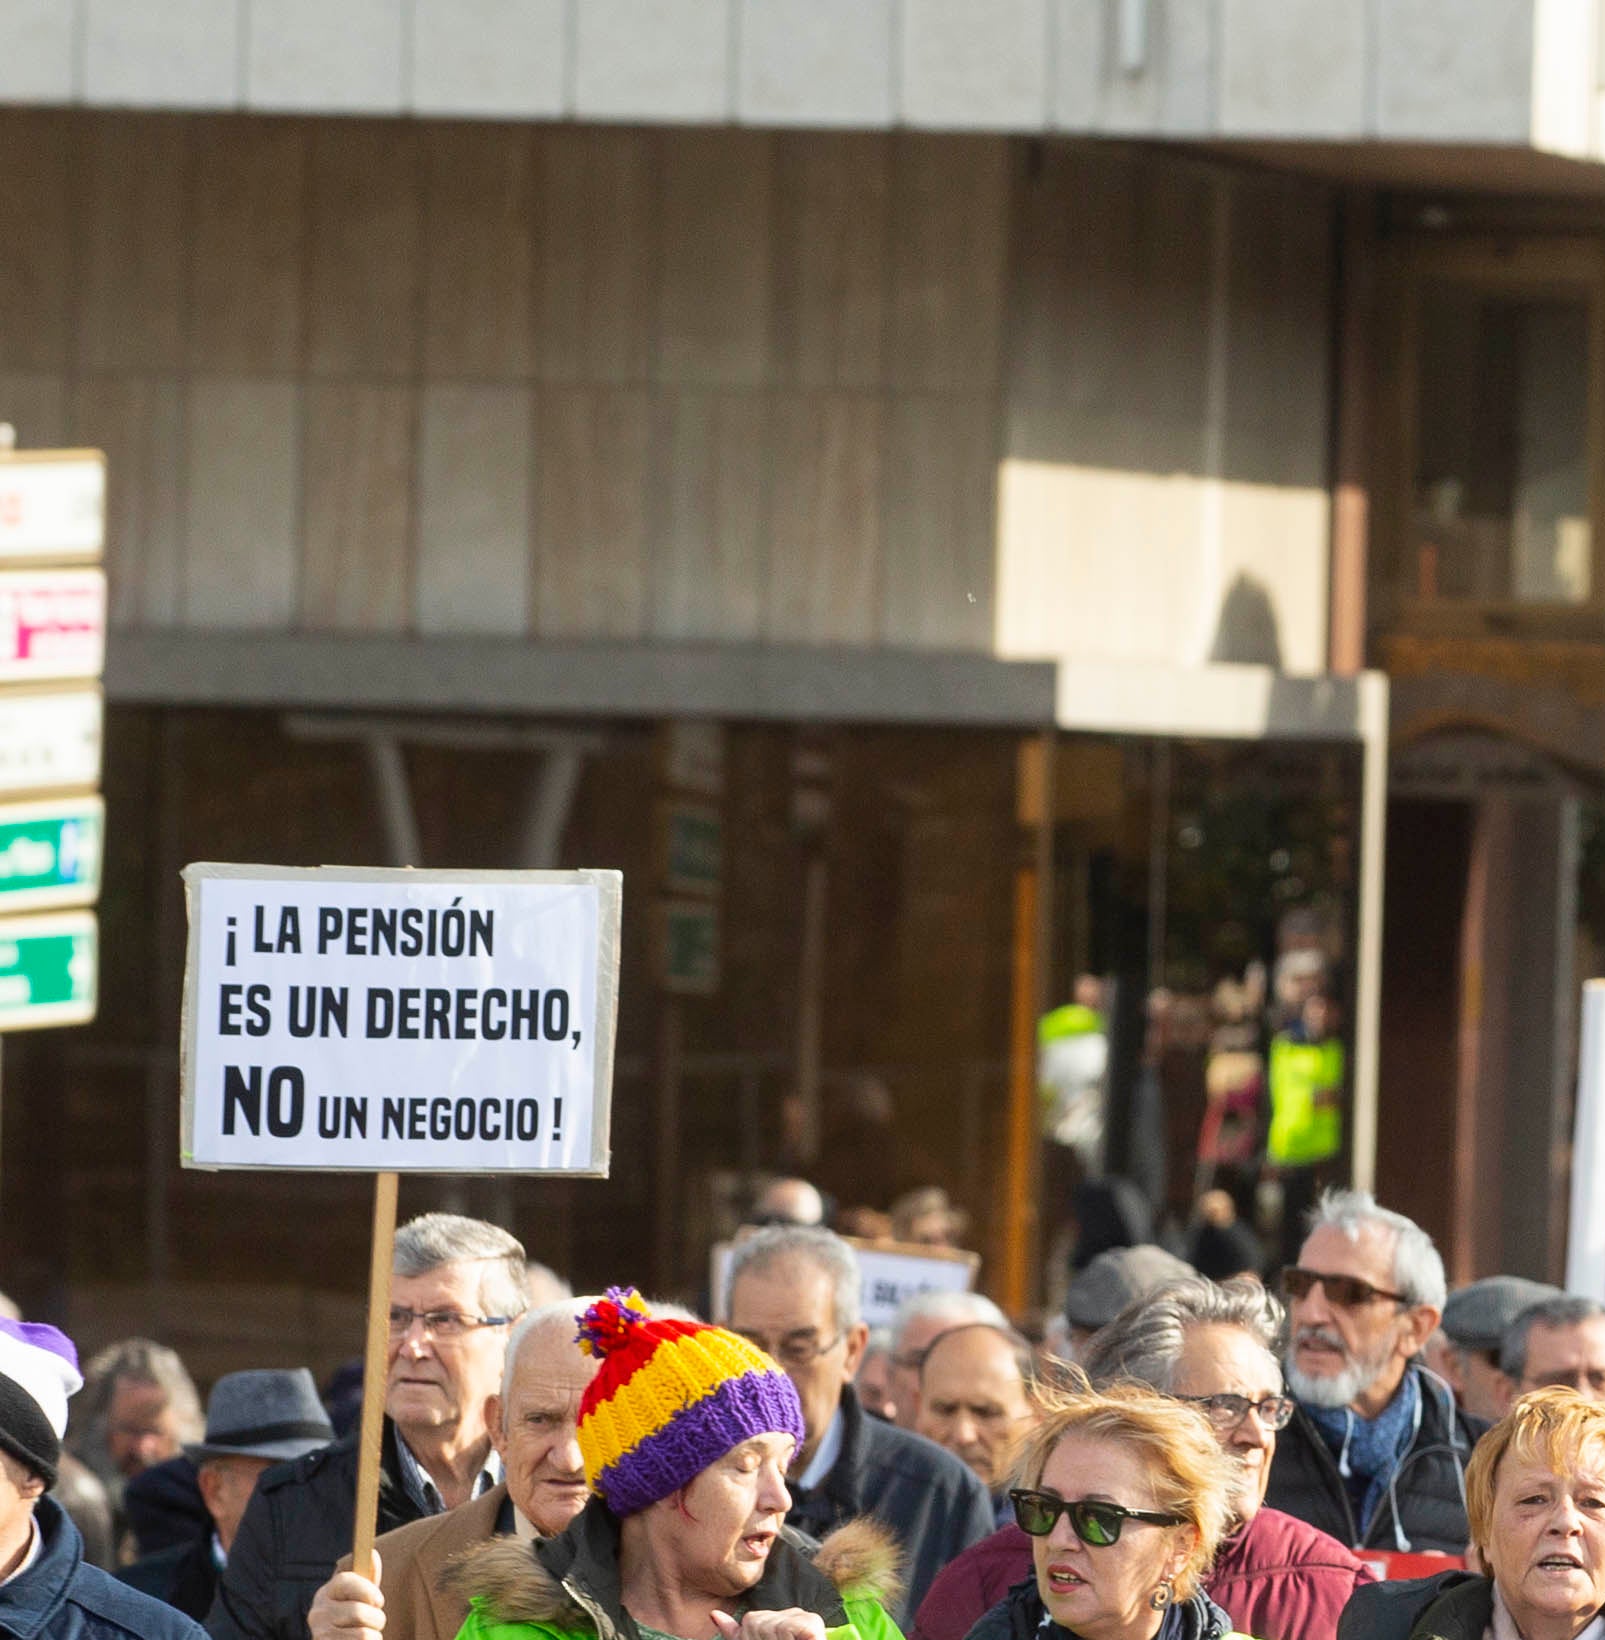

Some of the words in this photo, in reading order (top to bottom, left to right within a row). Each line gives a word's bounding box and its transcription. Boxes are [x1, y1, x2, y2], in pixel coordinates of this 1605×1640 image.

[253, 904, 301, 955] LA
[317, 896, 495, 957] PENSIÓN
[219, 983, 271, 1037] ES
[289, 985, 348, 1039] UN
[366, 988, 582, 1050] DERECHO,
[222, 1064, 305, 1138] NO
[318, 1096, 368, 1140] UN
[382, 1097, 539, 1141] NEGOCIO
